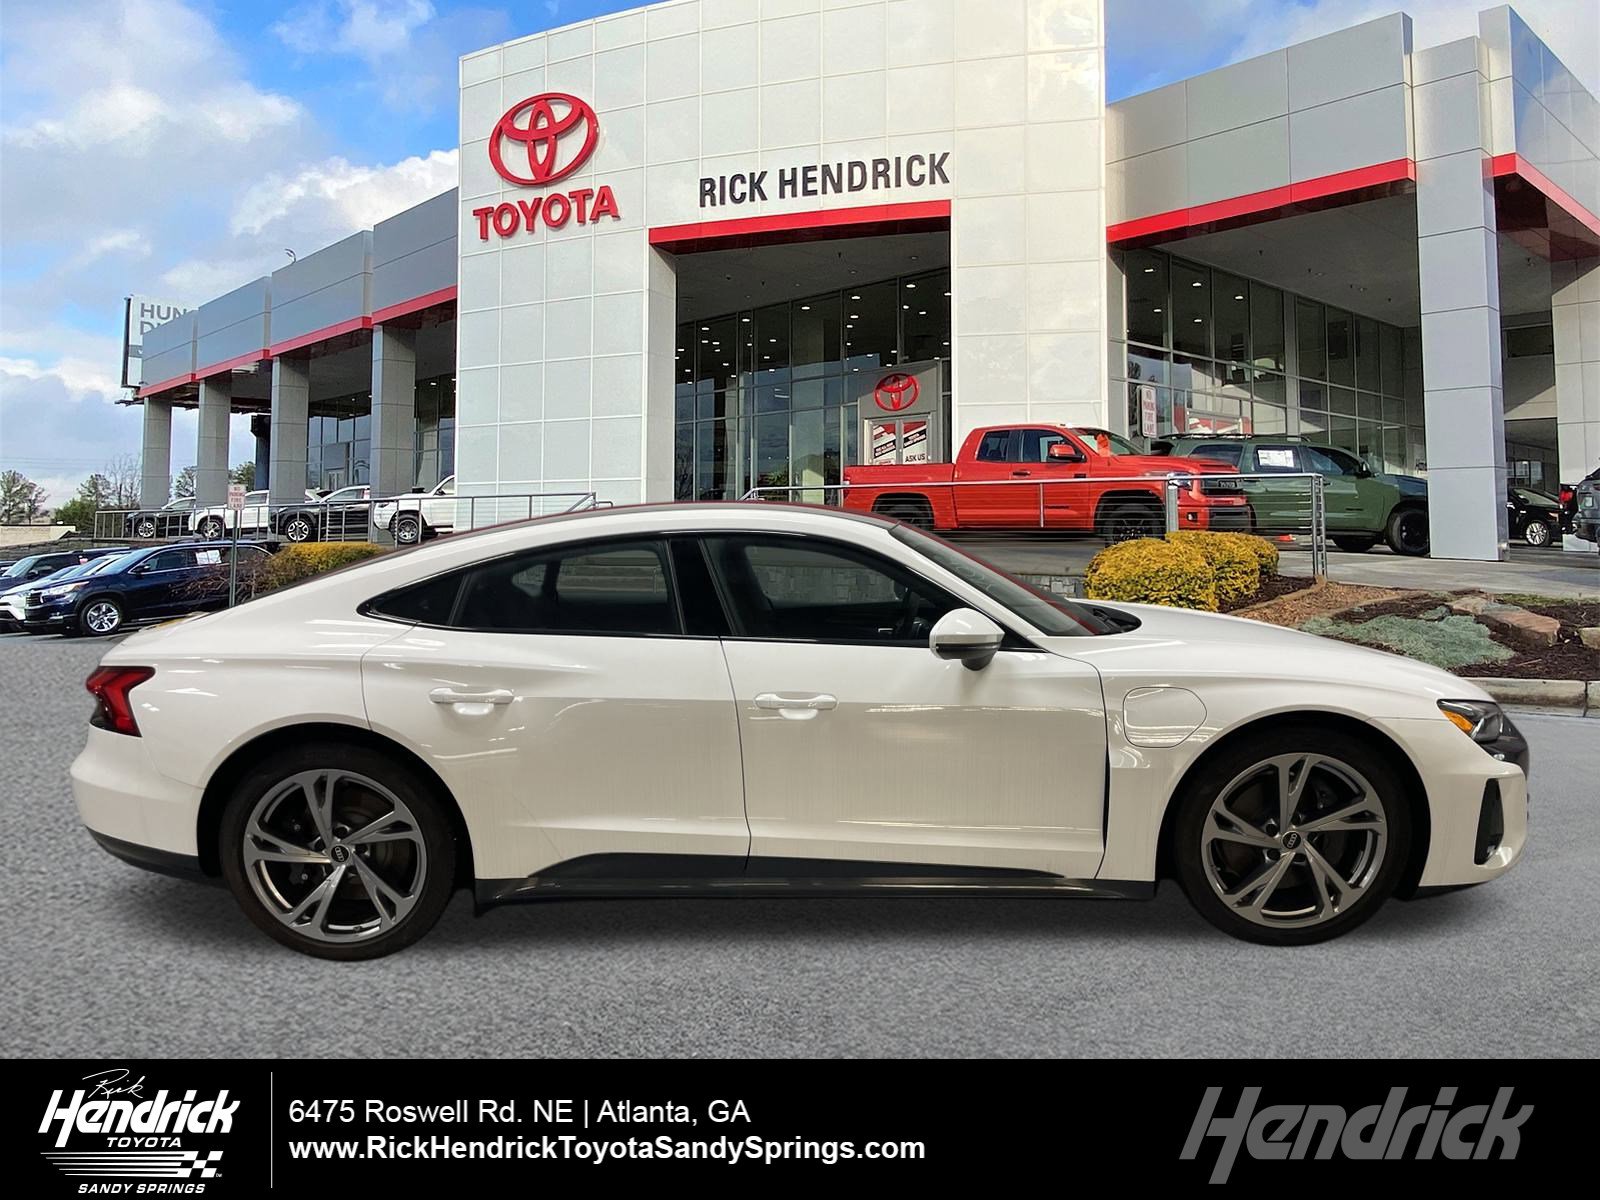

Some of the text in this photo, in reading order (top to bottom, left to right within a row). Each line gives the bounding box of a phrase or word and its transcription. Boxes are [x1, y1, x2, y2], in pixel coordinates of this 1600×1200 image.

[699, 151, 950, 208] RICK HENDRICK
[473, 185, 620, 241] TOYOTA
[905, 453, 926, 463] ASK US
